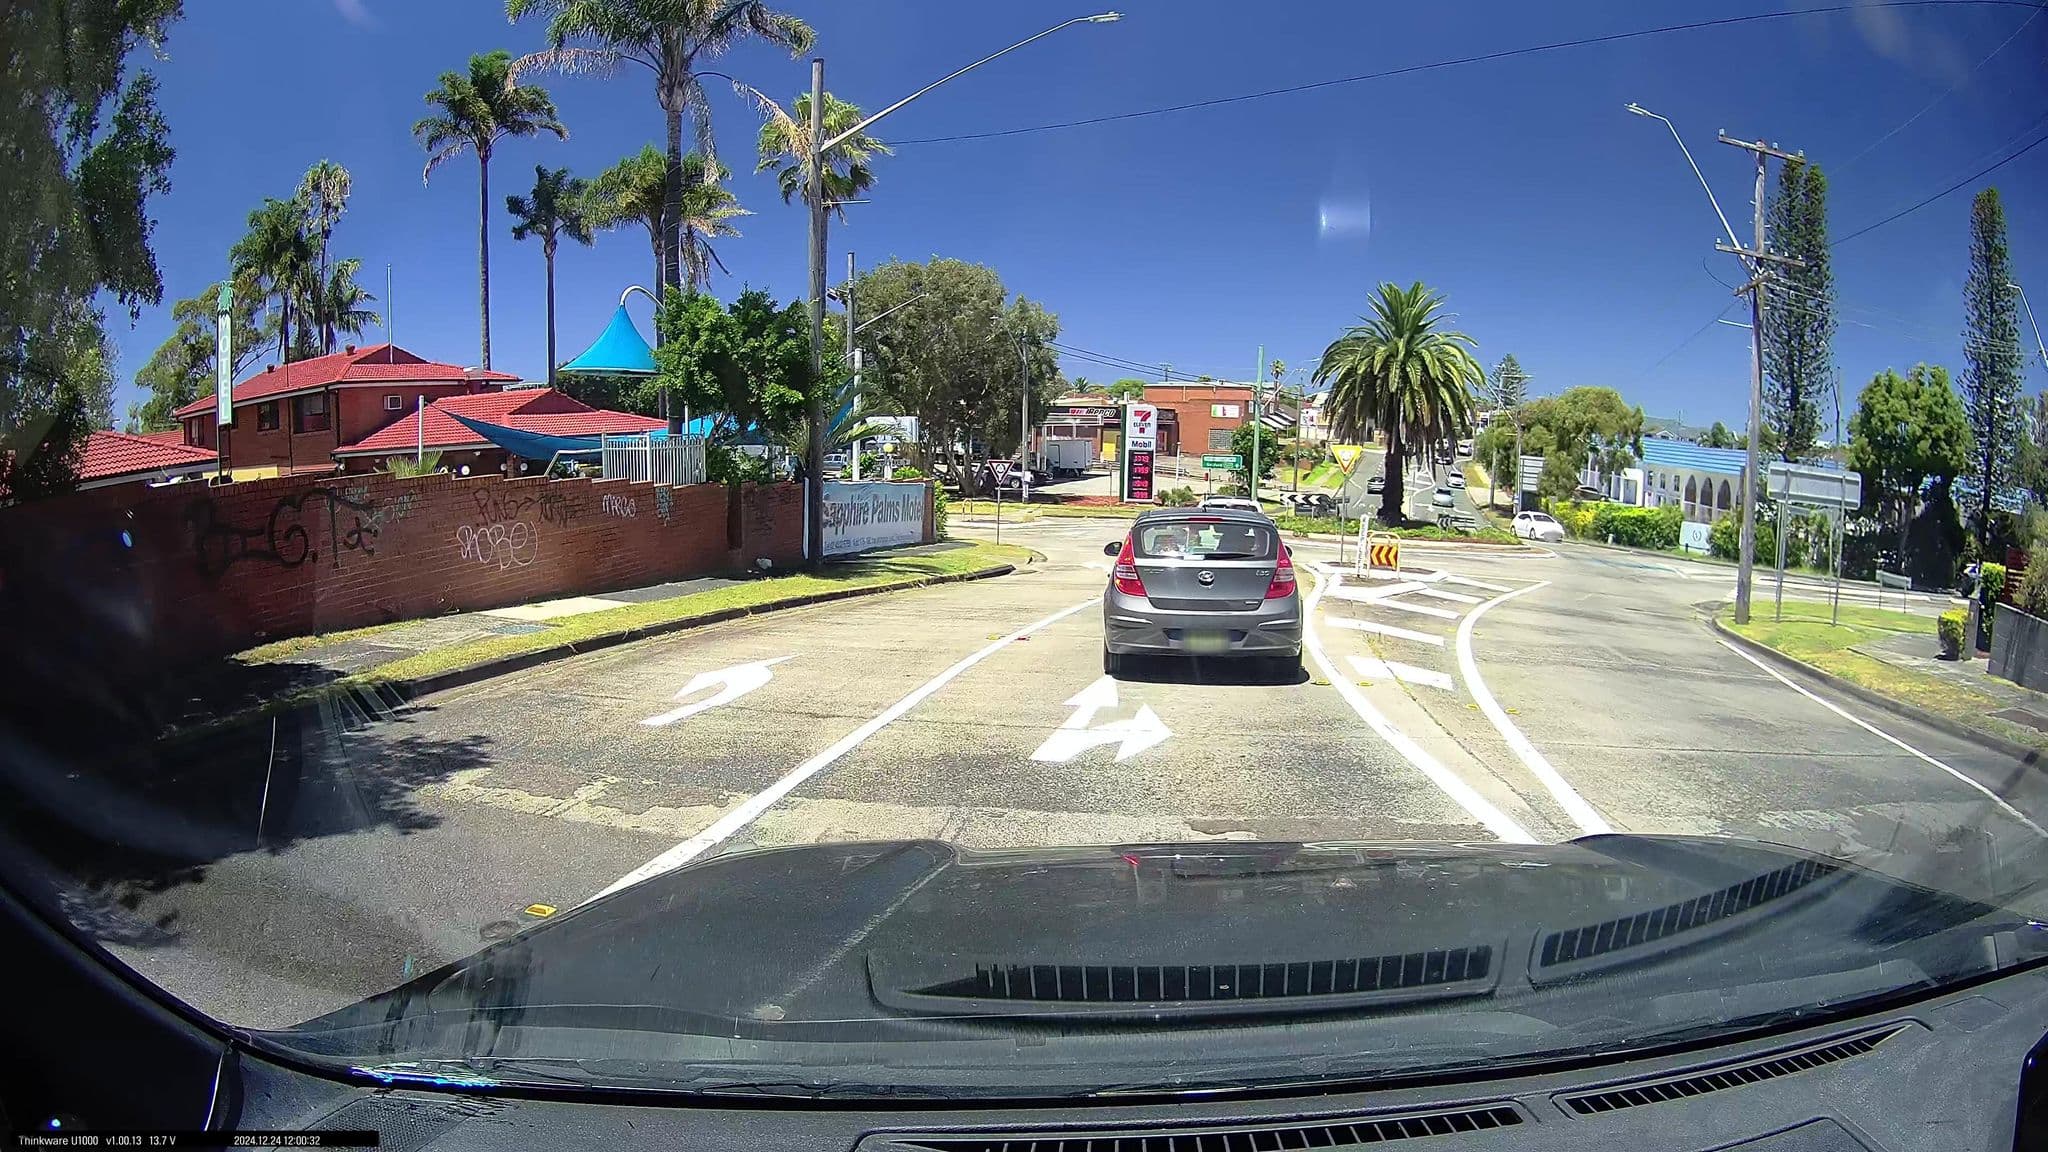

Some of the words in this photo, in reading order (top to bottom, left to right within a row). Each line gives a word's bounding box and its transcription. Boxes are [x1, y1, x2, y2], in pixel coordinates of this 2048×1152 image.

[219, 316, 231, 420] MOTEL
[1131, 440, 1152, 449] Mobil
[871, 493, 900, 524] Palms
